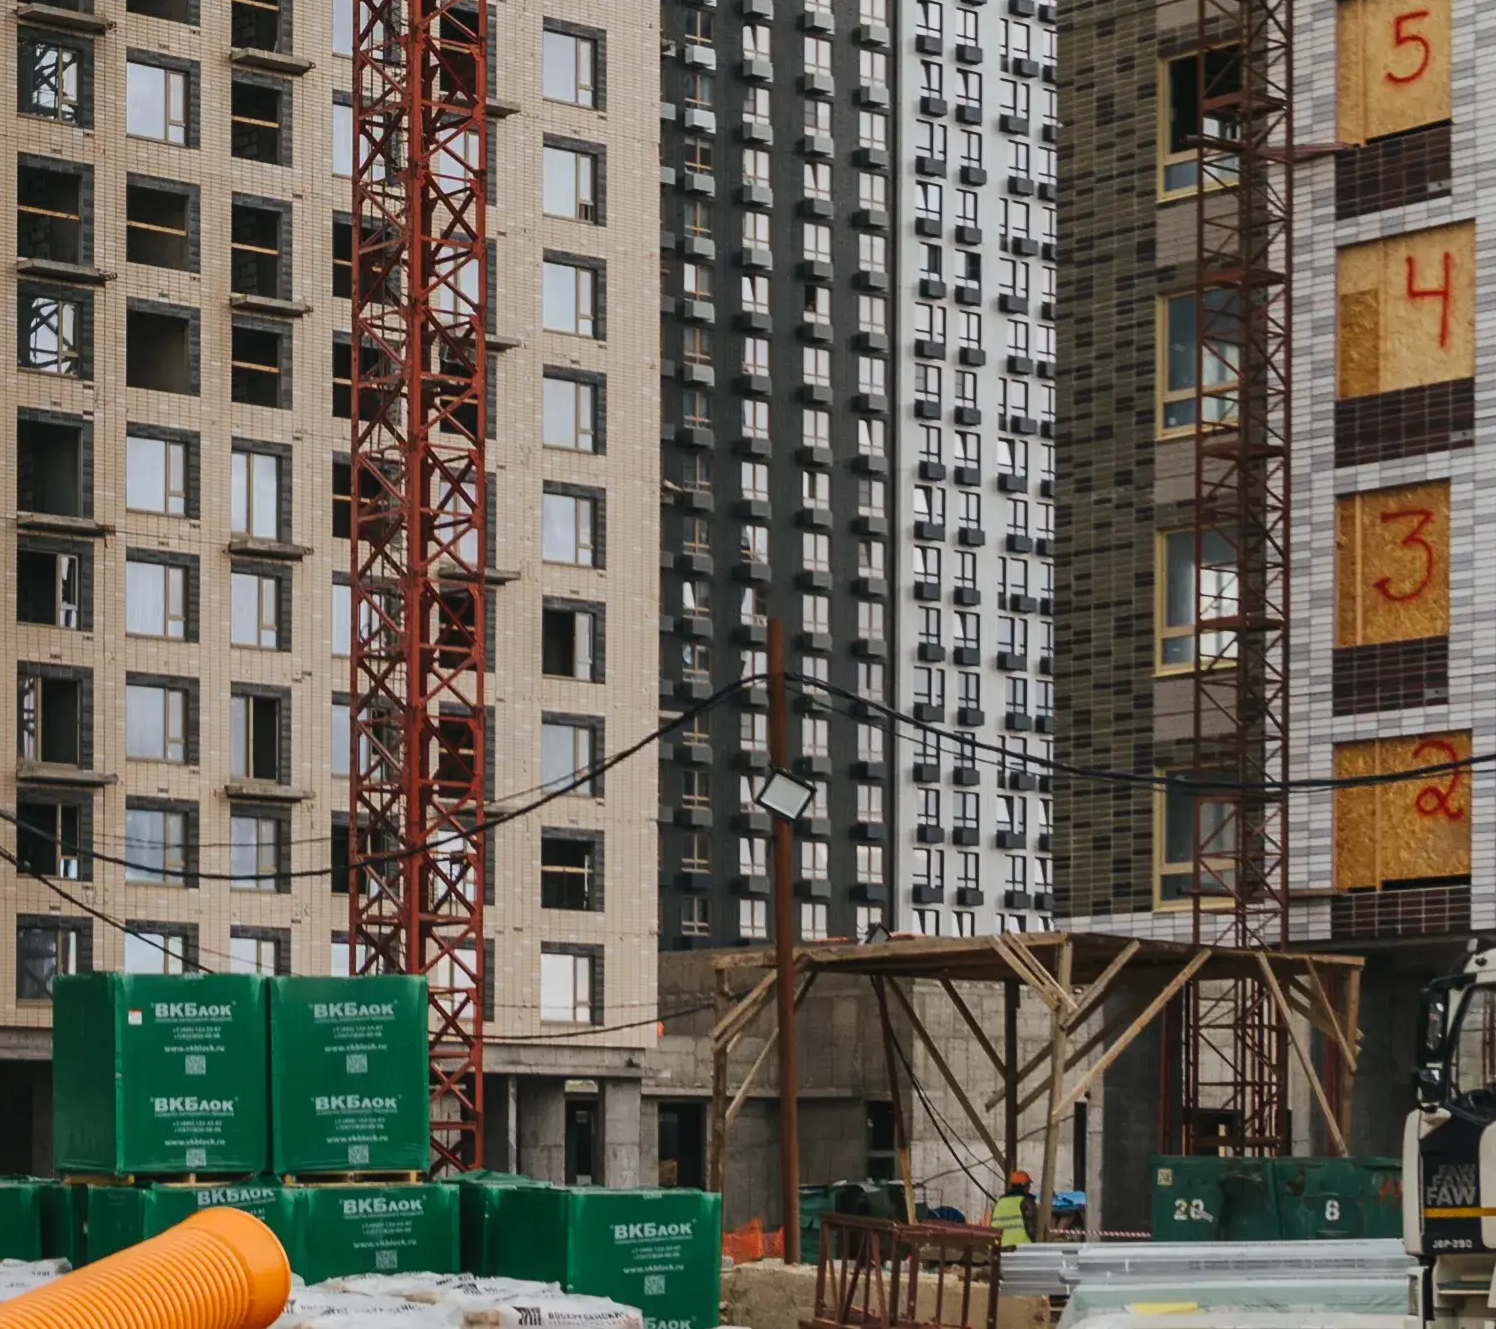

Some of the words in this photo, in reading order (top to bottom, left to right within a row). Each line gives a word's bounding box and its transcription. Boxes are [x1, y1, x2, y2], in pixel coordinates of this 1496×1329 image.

[1384, 10, 1431, 86] 5
[1406, 251, 1451, 348] 4
[1373, 509, 1436, 602] 3
[1412, 740, 1464, 820] 2
[1325, 1199, 1340, 1221] 8
[1426, 1186, 1477, 1205] FAW
